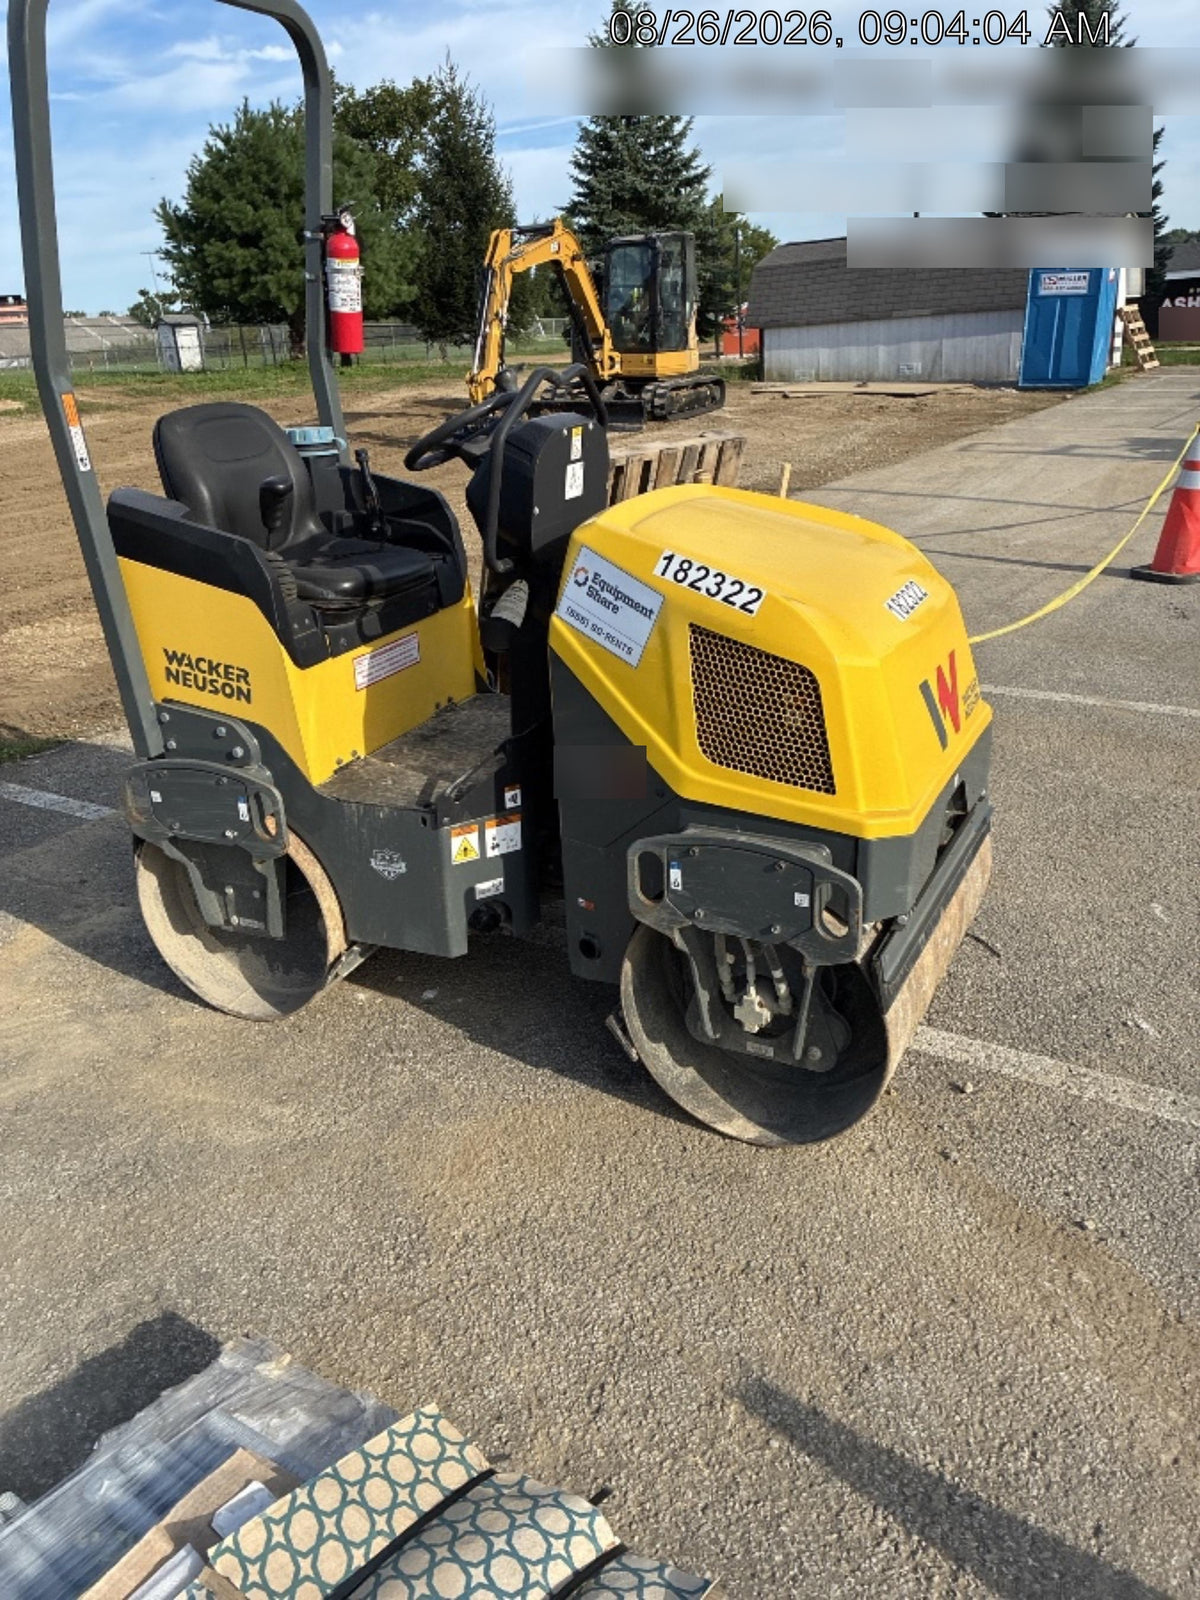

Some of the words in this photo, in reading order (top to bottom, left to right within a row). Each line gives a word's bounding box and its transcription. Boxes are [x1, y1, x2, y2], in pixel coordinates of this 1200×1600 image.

[586, 585, 620, 614] Share
[591, 572, 655, 620] Equipment
[660, 553, 763, 614] 182322
[887, 581, 928, 619] 182322
[163, 647, 251, 686] WACKER
[165, 666, 251, 704] NEUSON
